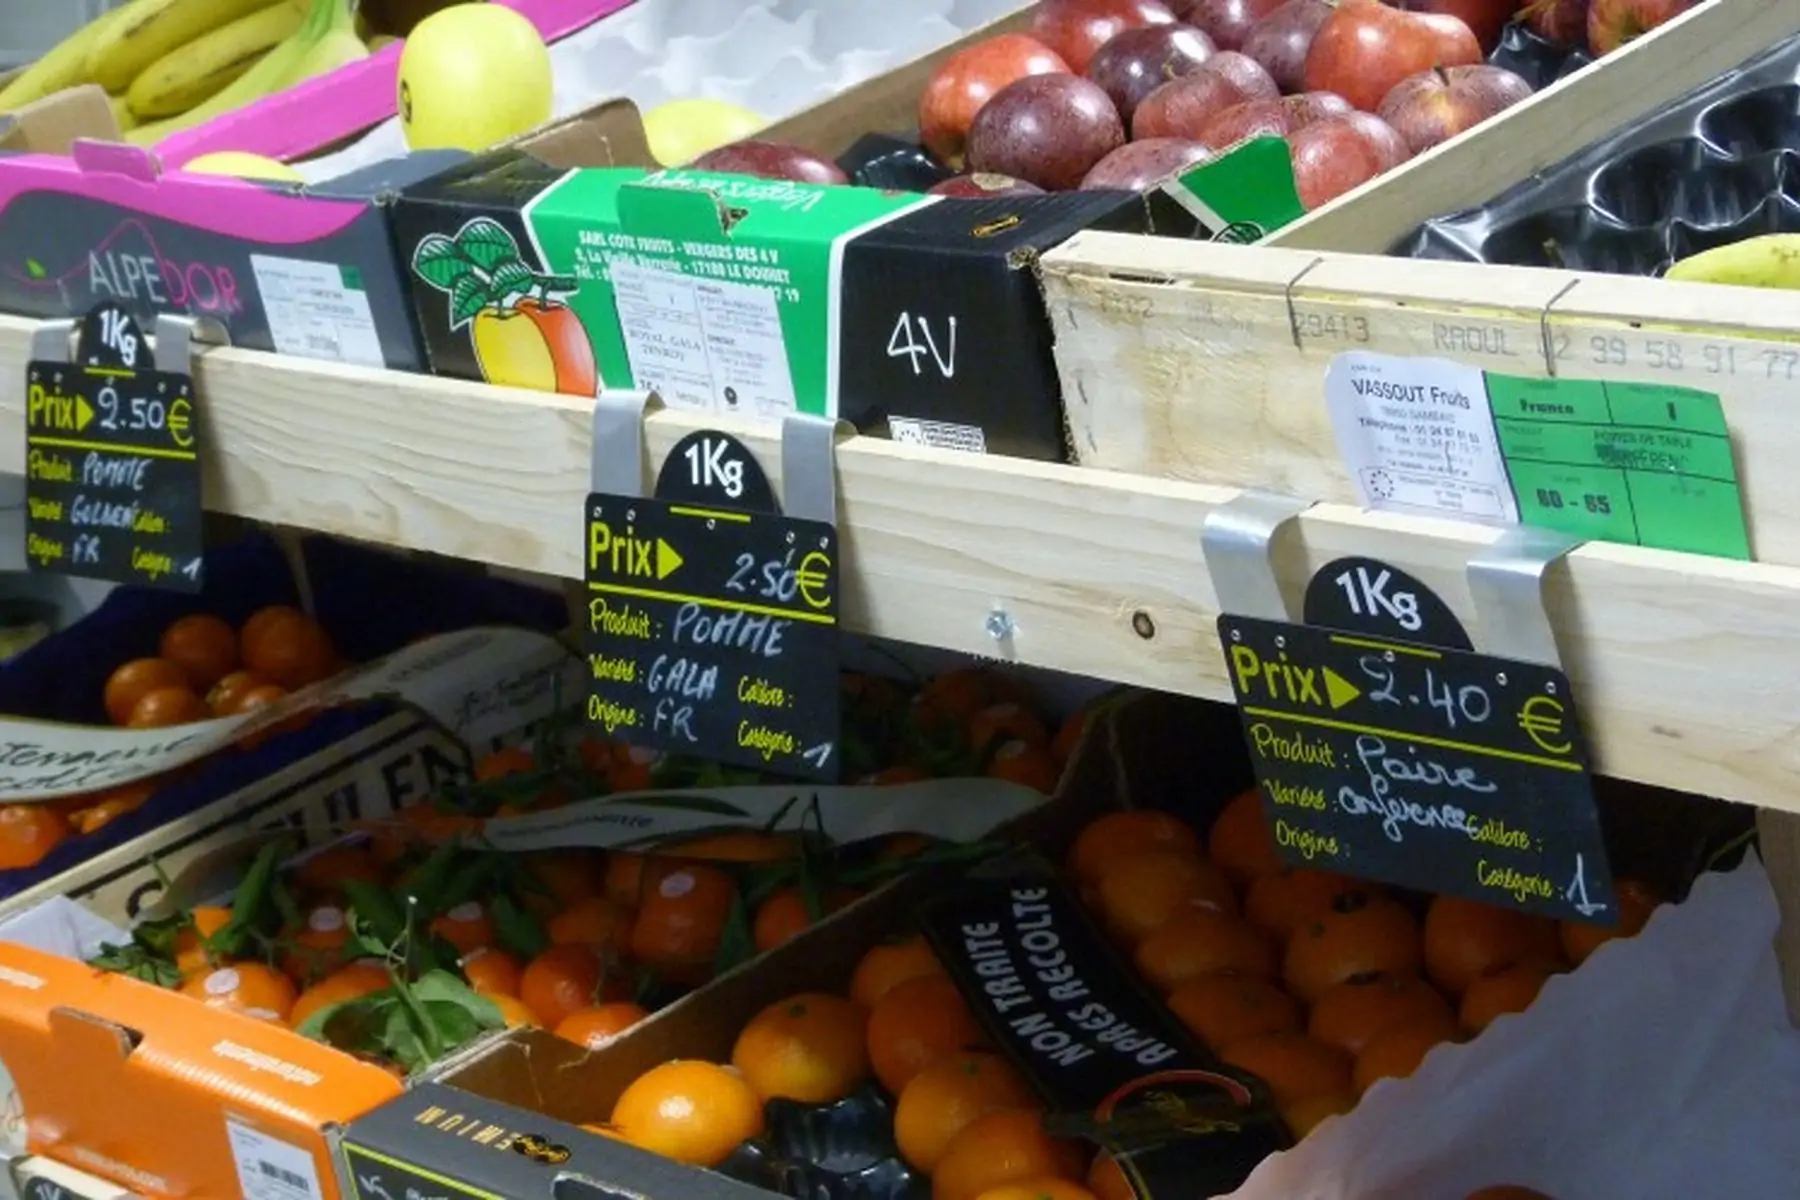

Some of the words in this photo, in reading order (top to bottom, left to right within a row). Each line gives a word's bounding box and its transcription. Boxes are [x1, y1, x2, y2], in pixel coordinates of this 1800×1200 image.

[100, 308, 136, 366] 1Kg
[887, 311, 957, 378] 4V
[28, 383, 74, 431] Prix
[1351, 378, 1425, 403] VASSOUT
[685, 437, 745, 498] 1Kg
[588, 521, 654, 578] Prix
[1335, 565, 1423, 632] 1Kg
[672, 601, 790, 657] POMME
[647, 654, 719, 701] GALA
[1230, 643, 1324, 707] Prix
[1358, 654, 1493, 729] 2.40
[653, 696, 699, 742] FR
[962, 921, 1034, 1014] TRAITE
[1011, 887, 1091, 1002] RECOLTE
[1008, 1011, 1097, 1067] NON
[1066, 1002, 1179, 1066] APRES
